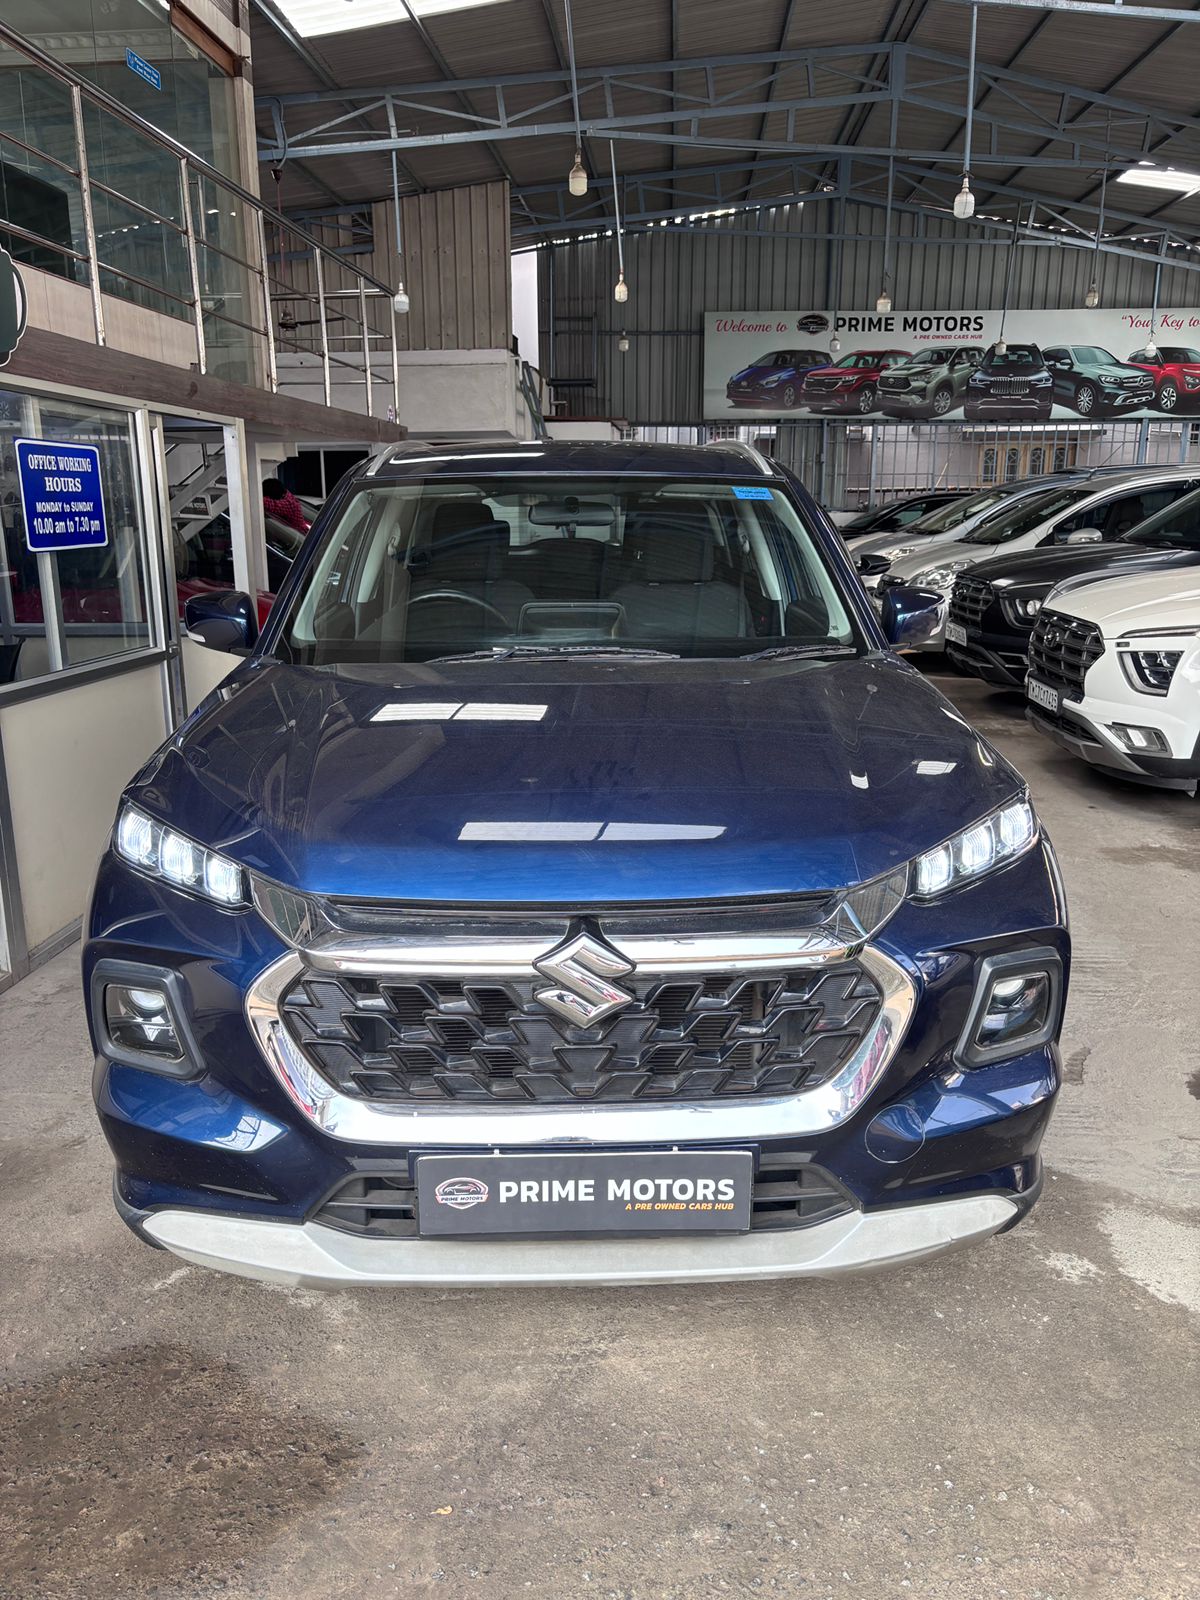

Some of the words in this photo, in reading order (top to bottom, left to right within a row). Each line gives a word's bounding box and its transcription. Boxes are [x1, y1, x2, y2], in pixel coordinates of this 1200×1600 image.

[715, 318, 772, 333] Welcome
[775, 321, 788, 333] to
[835, 316, 895, 332] PRIME
[902, 316, 984, 332] MOTORS
[1160, 313, 1185, 331] Key
[1188, 316, 1200, 327] to
[28, 454, 57, 470] OFFICE
[57, 456, 92, 472] WORKING
[45, 477, 82, 492] HOURS
[36, 502, 62, 513] MONDAY
[63, 503, 70, 512] to
[70, 501, 94, 512] SUNDAY
[33, 517, 54, 535] 10.00
[54, 520, 66, 533] am
[66, 518, 74, 533] to
[75, 516, 90, 532] 7.30
[91, 519, 101, 535] pm
[499, 1179, 595, 1203] PRIME
[607, 1178, 735, 1202] MOTORS
[625, 1203, 633, 1211] A
[634, 1203, 653, 1211] PRE
[654, 1203, 686, 1211] OWNED
[688, 1202, 713, 1210] CARS
[714, 1202, 735, 1210] HUB
